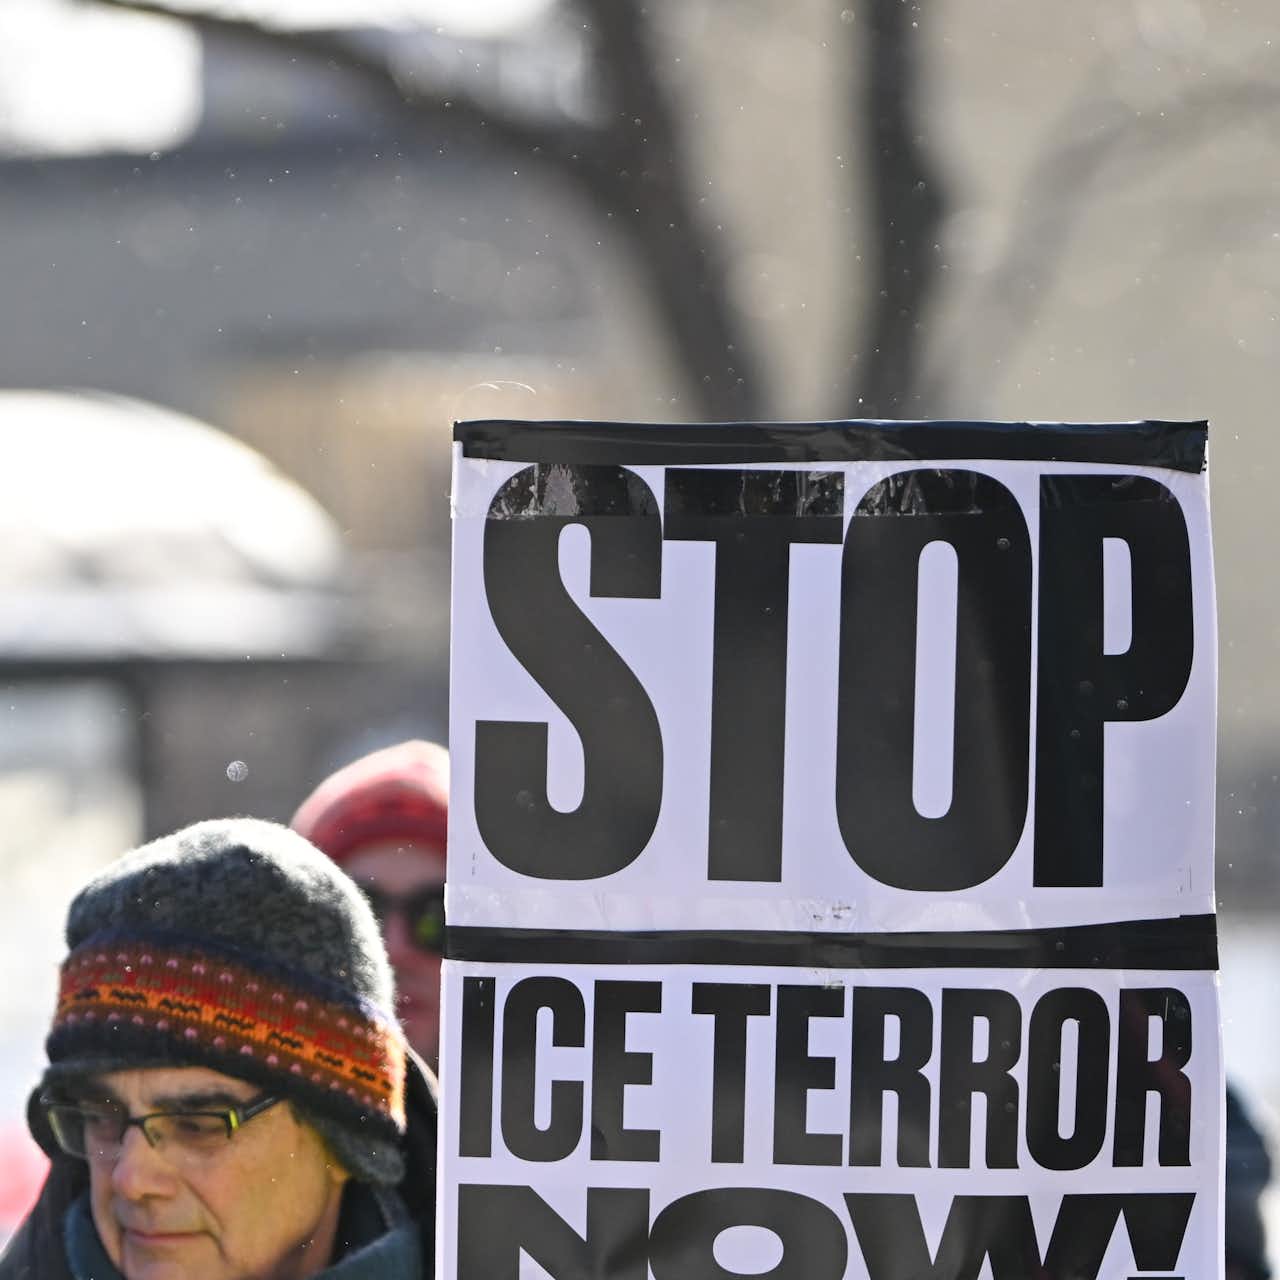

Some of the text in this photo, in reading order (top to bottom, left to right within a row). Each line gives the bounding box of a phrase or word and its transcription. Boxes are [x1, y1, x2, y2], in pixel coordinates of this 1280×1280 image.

[474, 463, 1194, 892] STOP
[458, 976, 1193, 1171] ICE TERROR
